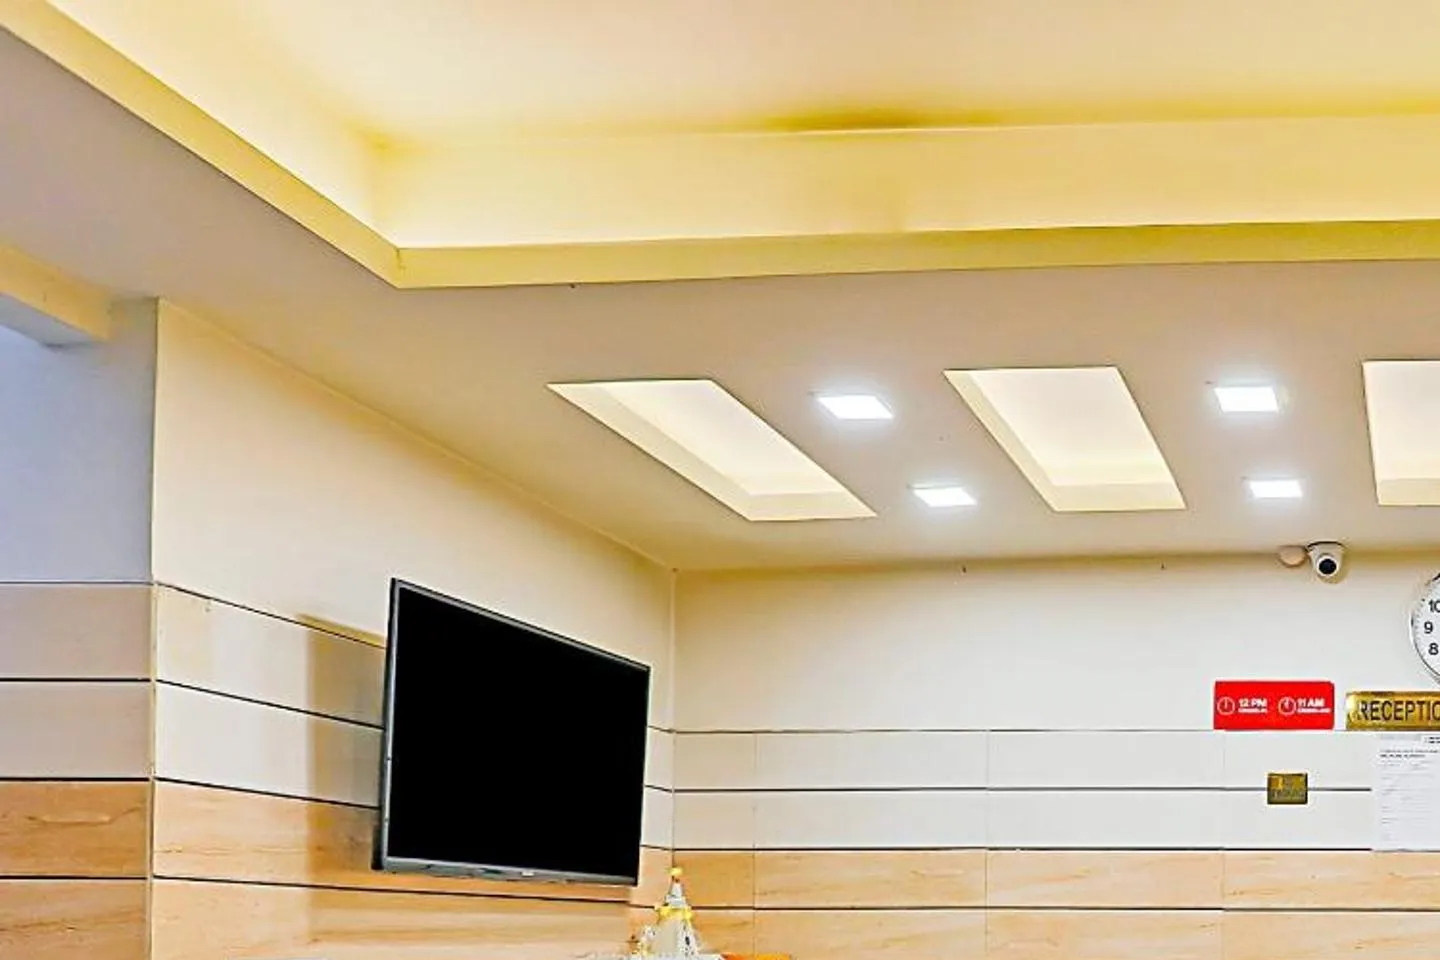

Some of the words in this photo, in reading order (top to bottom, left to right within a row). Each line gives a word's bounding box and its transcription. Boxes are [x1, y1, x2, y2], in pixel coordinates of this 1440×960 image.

[1423, 621, 1434, 634] 9
[1428, 642, 1439, 655] 8
[1238, 698, 1249, 707] 12
[1251, 698, 1268, 707] PM
[1297, 698, 1306, 707] 11
[1307, 698, 1325, 707] AM
